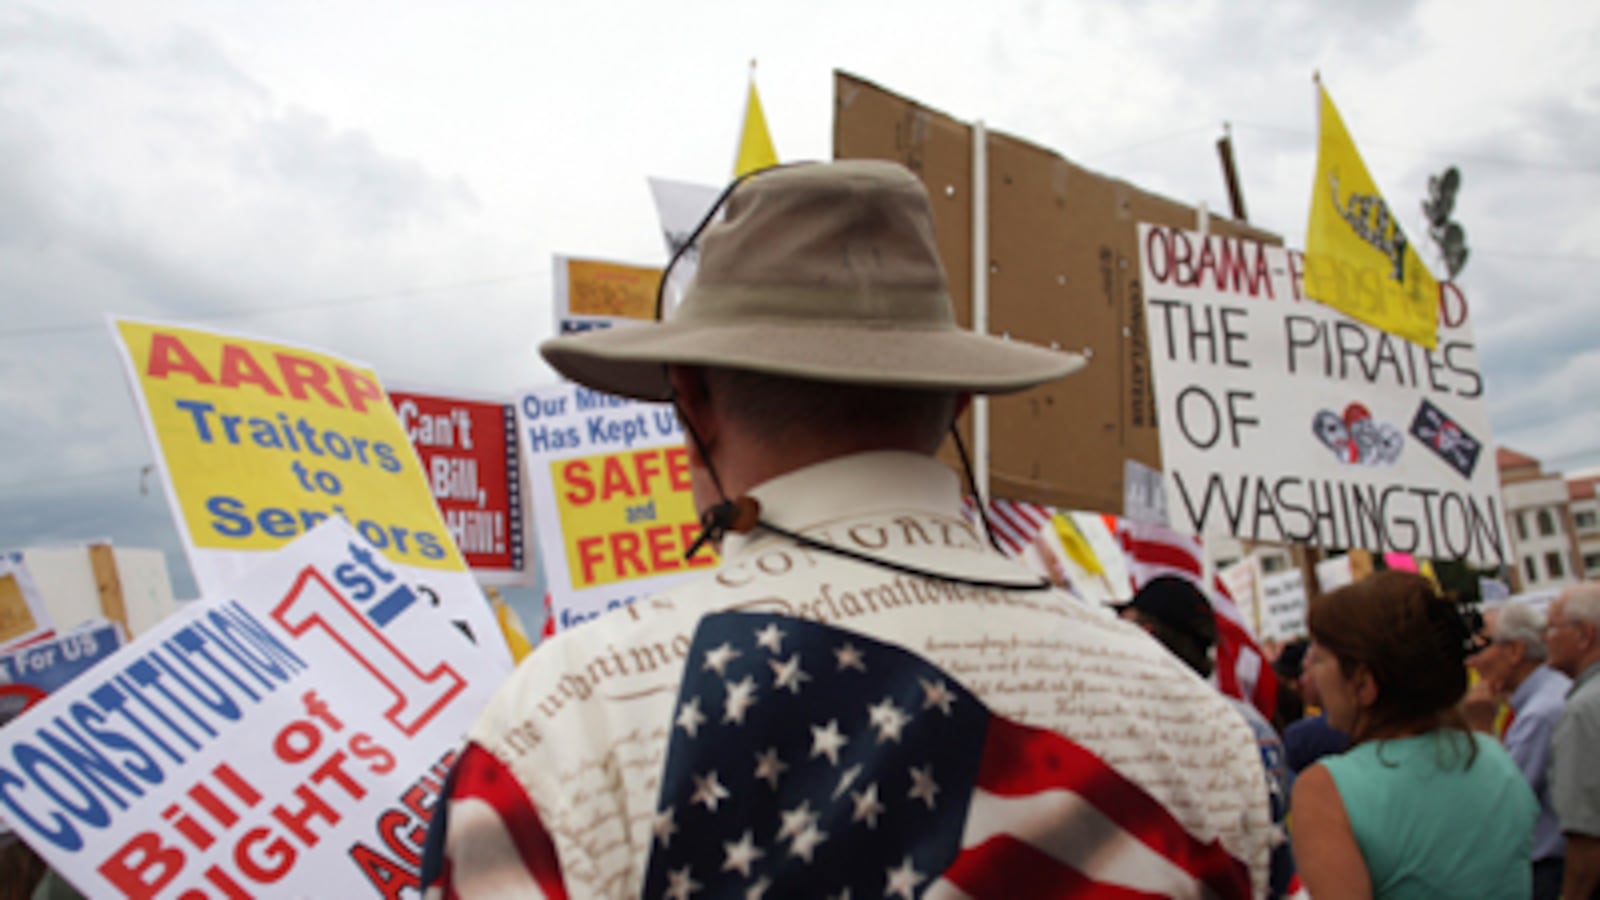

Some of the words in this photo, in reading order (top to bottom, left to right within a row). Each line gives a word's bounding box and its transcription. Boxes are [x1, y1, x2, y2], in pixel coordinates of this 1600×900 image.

[1149, 299, 1251, 368] THE
[1284, 315, 1484, 398] PIRATES
[147, 333, 382, 414] AARP
[176, 400, 403, 474] Traitors
[400, 400, 473, 450] Can't
[523, 395, 567, 420] Our
[529, 426, 581, 452] Has
[587, 414, 648, 449] Kept
[1176, 386, 1259, 449] OF
[291, 460, 343, 497] to
[430, 455, 487, 509] Bill,
[563, 447, 692, 507] SAFE
[447, 509, 505, 555] Hill!
[625, 500, 656, 523] and
[1173, 470, 1507, 567] WASHINGTON
[576, 522, 715, 584] FREE
[14, 653, 54, 676] For
[61, 638, 99, 662] US
[0, 600, 308, 853] CONSTITUTION
[97, 762, 264, 900] Bill
[273, 690, 344, 764] of
[177, 733, 396, 900] IGHTS
